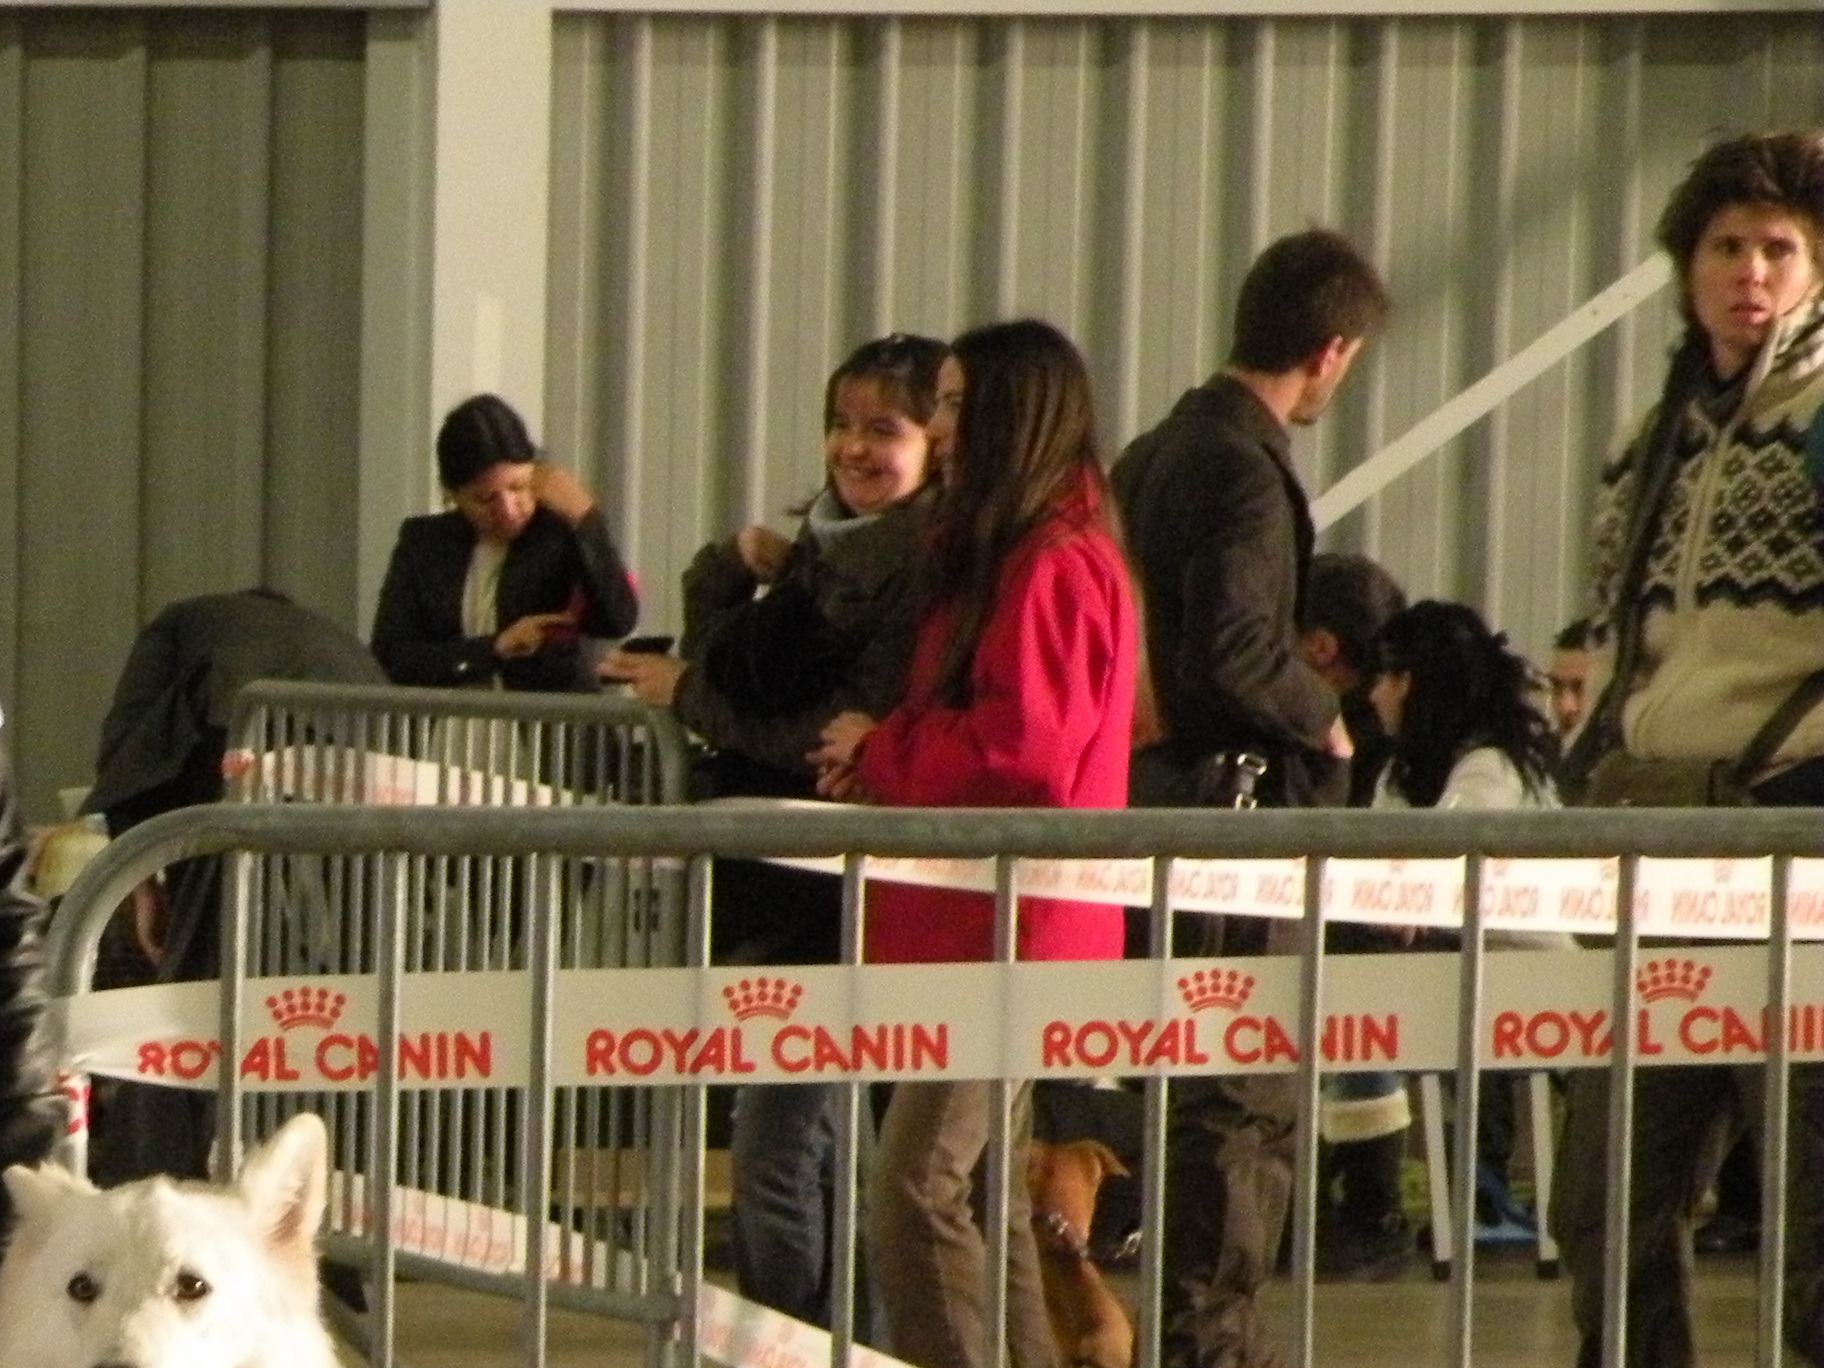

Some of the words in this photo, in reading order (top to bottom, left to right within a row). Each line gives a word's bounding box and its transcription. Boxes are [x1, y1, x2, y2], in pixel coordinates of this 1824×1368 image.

[586, 1027, 755, 1076] ROYAL
[771, 1024, 949, 1072] CANIN
[1042, 1019, 1209, 1068] ROYAL
